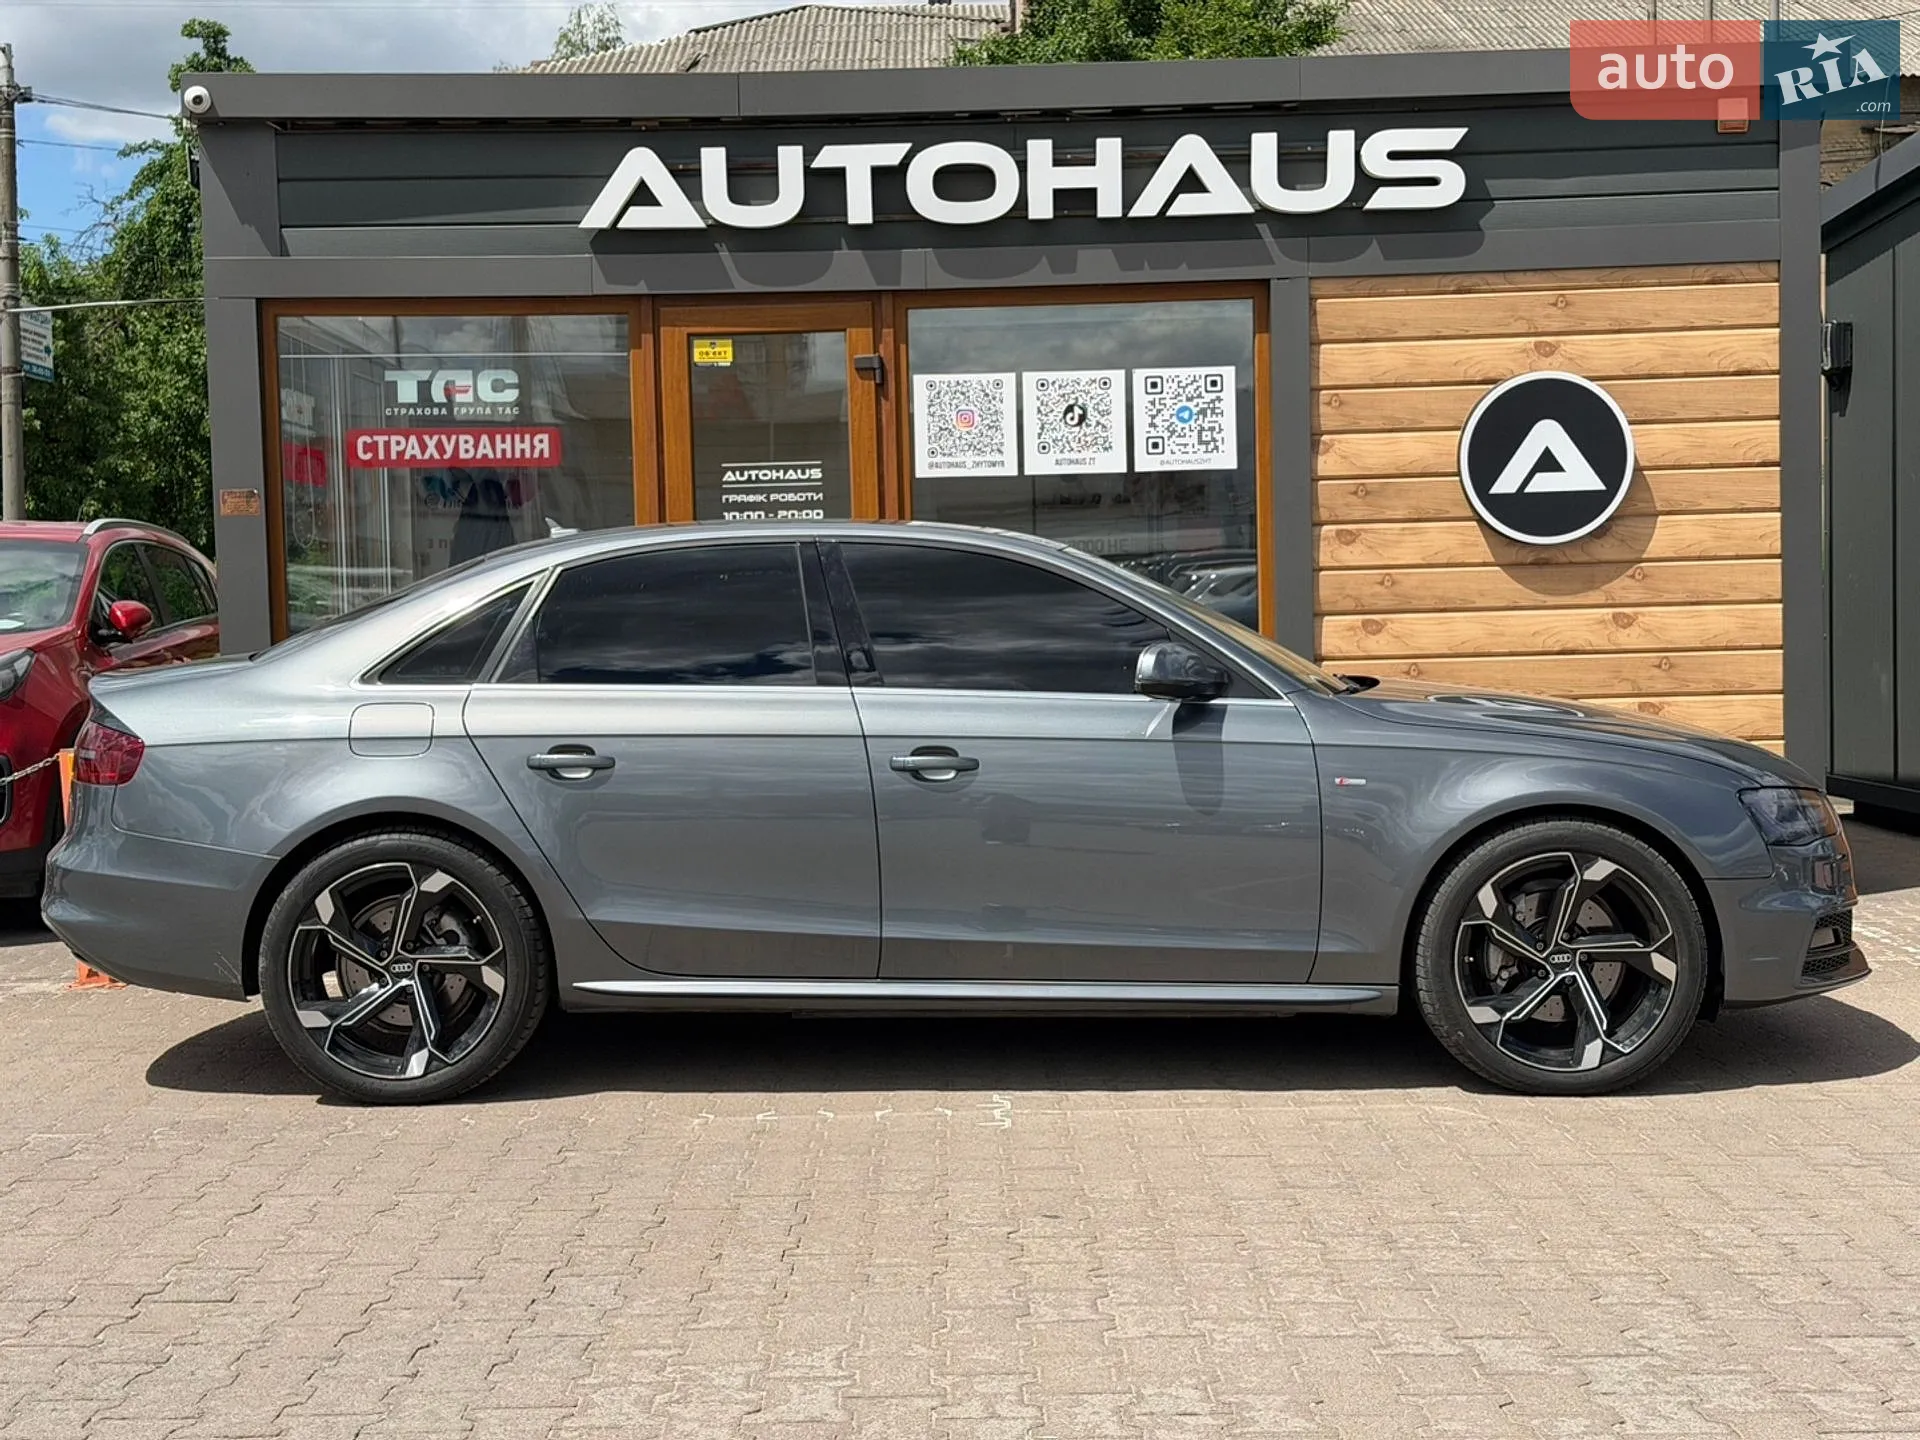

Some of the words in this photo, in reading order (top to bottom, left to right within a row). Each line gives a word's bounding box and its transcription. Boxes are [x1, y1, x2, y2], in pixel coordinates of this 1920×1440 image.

[578, 127, 1468, 230] AUTOHAUS
[385, 407, 447, 416] СТРАХОВА
[454, 407, 492, 415] ГРУПА
[498, 406, 520, 415] ТАС
[356, 433, 550, 460] СТРАХУВАННЯ
[1055, 458, 1086, 466] AUTOHAUS
[1488, 418, 1607, 495] A
[722, 468, 823, 481] AUTOHAUS
[722, 493, 768, 503] ГРАФІК
[769, 492, 823, 502] РОБОТИ
[723, 511, 765, 520] 10:00
[777, 509, 824, 520] 20:00
